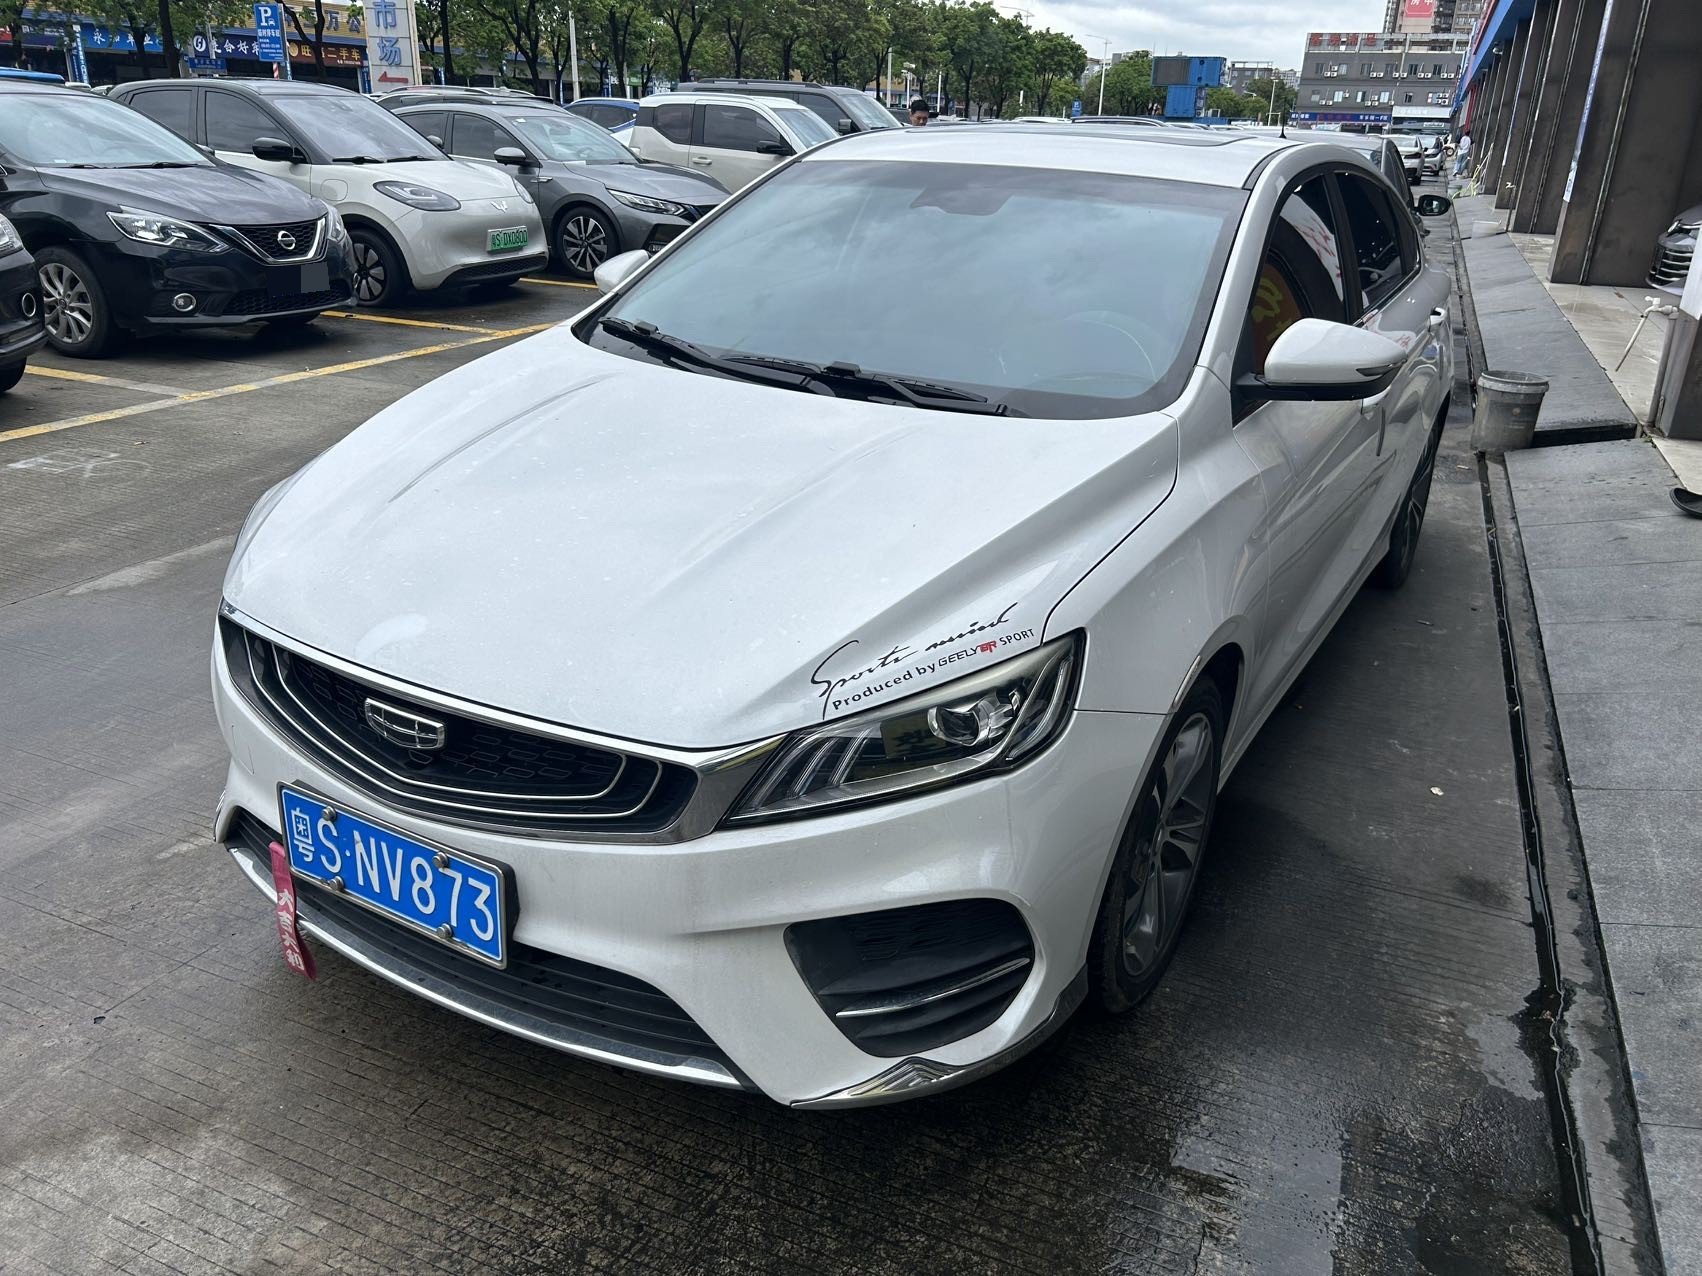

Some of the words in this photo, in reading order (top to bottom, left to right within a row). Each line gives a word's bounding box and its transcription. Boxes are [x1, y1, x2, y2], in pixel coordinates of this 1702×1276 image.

[258, 6, 272, 26] P
[372, 0, 402, 66] 市场
[301, 46, 361, 60] 旺二手车
[832, 670, 913, 710] Produced
[918, 662, 936, 676] by
[1000, 628, 1035, 646] SPORT
